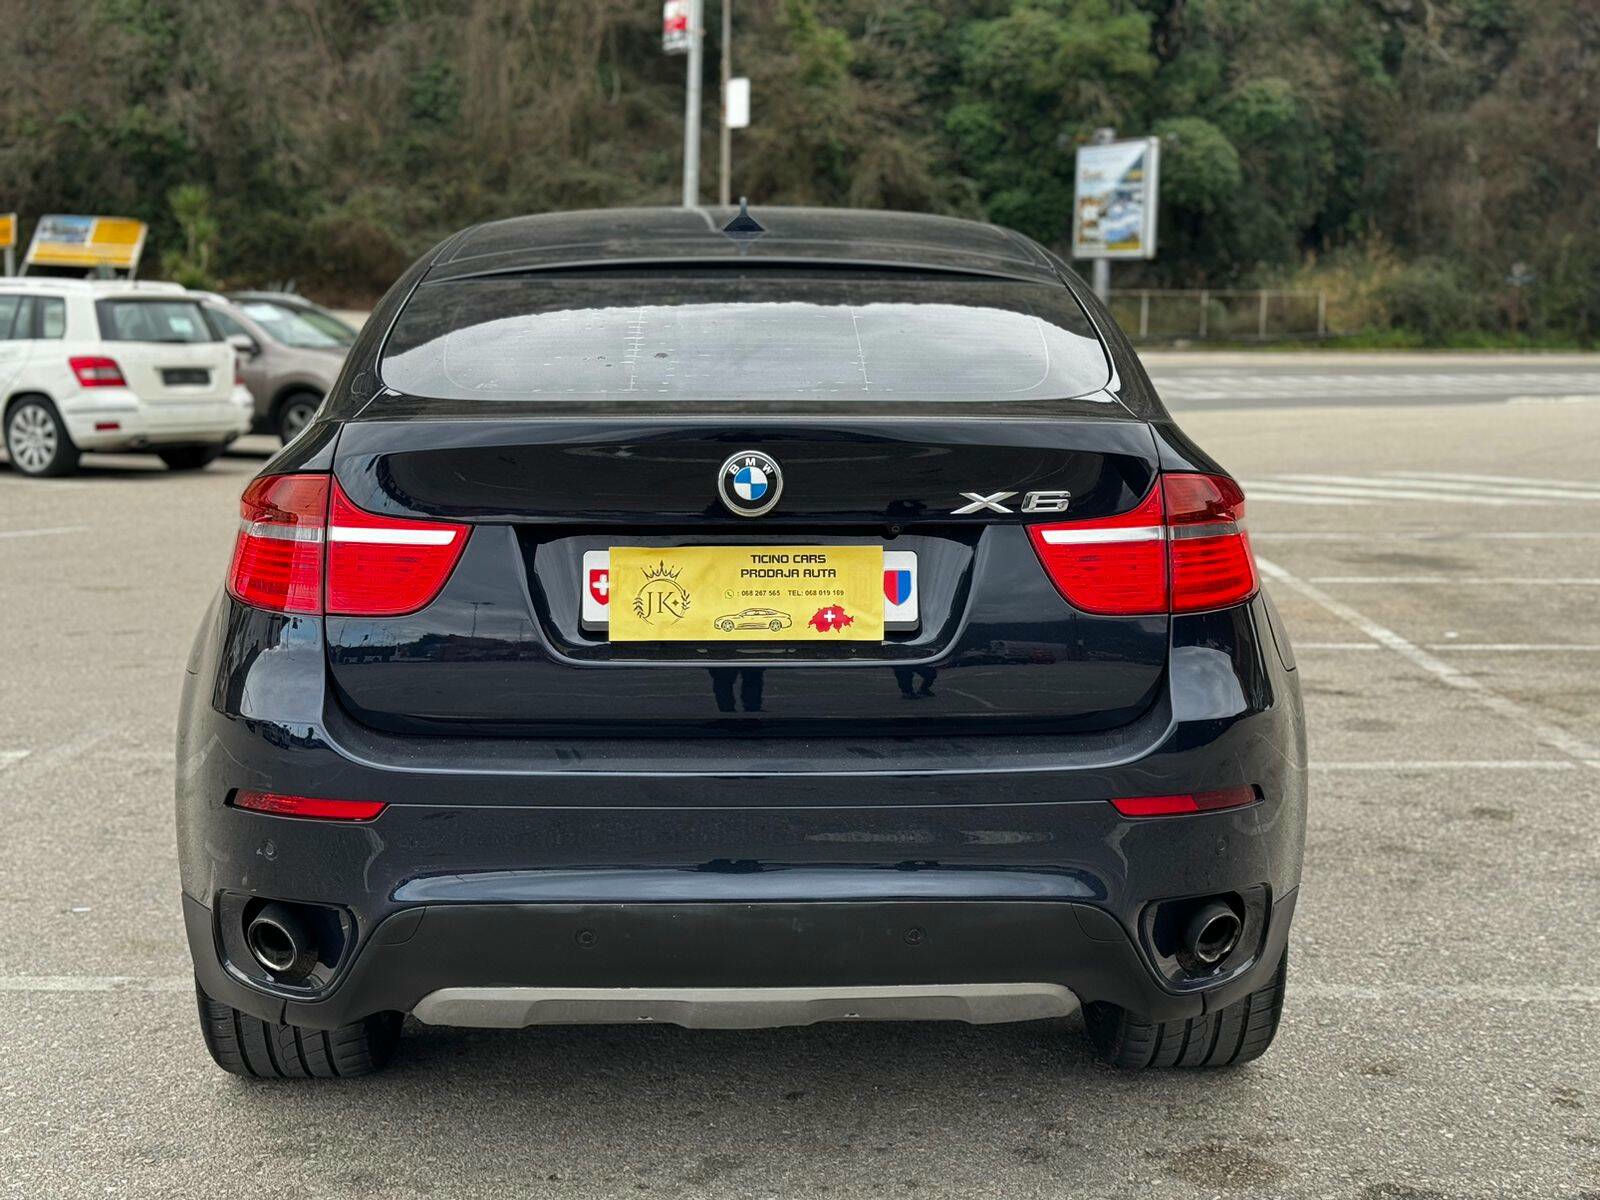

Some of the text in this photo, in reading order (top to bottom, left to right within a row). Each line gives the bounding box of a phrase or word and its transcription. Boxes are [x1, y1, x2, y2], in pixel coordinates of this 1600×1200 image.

[729, 457, 773, 475] BMW
[950, 491, 1072, 515] X6
[750, 554, 827, 564] TICINO CARS
[740, 568, 837, 578] PRODAJA AUTA
